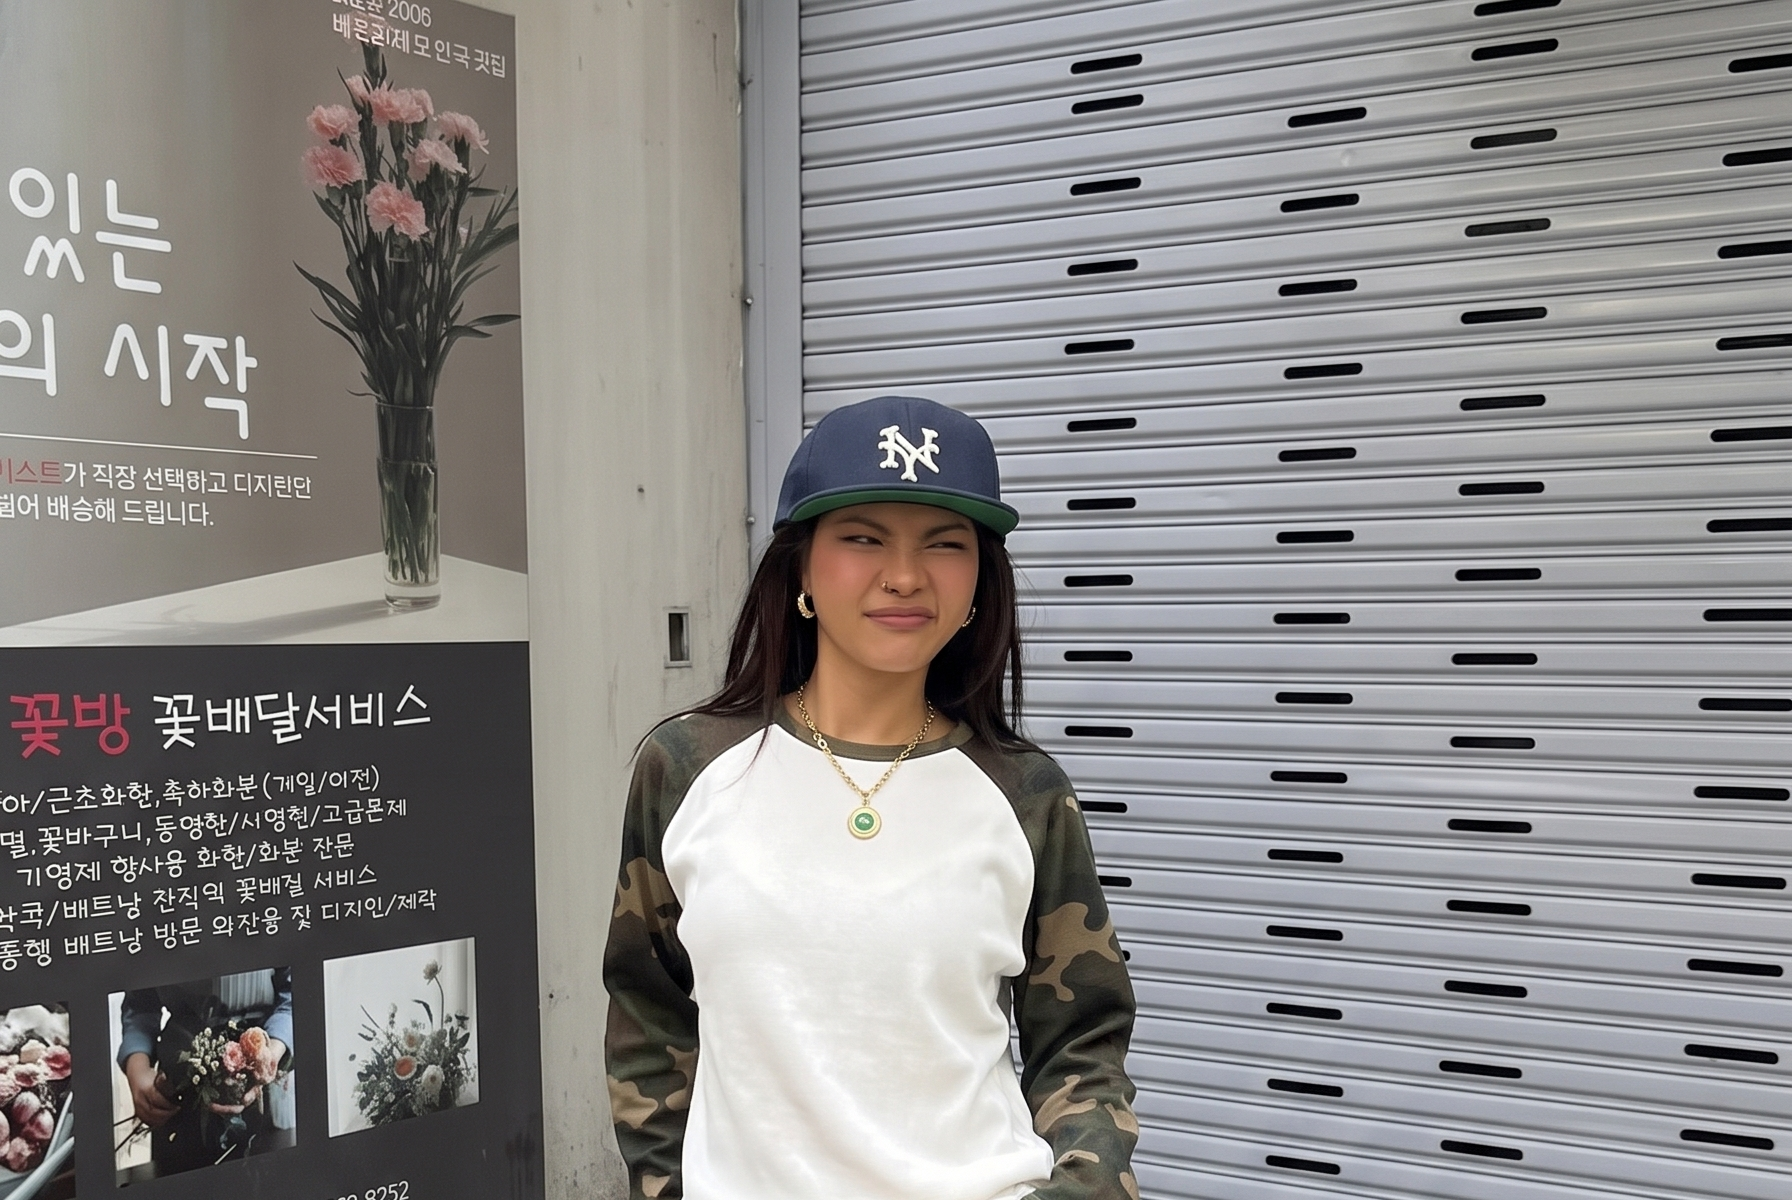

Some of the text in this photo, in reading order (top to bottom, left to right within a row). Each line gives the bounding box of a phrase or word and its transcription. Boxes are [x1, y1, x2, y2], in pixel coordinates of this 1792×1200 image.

[388, 0, 432, 28] 2006
[9, 167, 172, 294] 있는
[104, 323, 258, 440] 시작
[92, 464, 137, 490] 직장
[122, 499, 214, 527] 드립니다.
[10, 684, 431, 759] 꽃방 꽃배달서비스
[314, 864, 377, 889] 서비스
[64, 927, 143, 954] 배트낭
[153, 916, 202, 949] 방문
